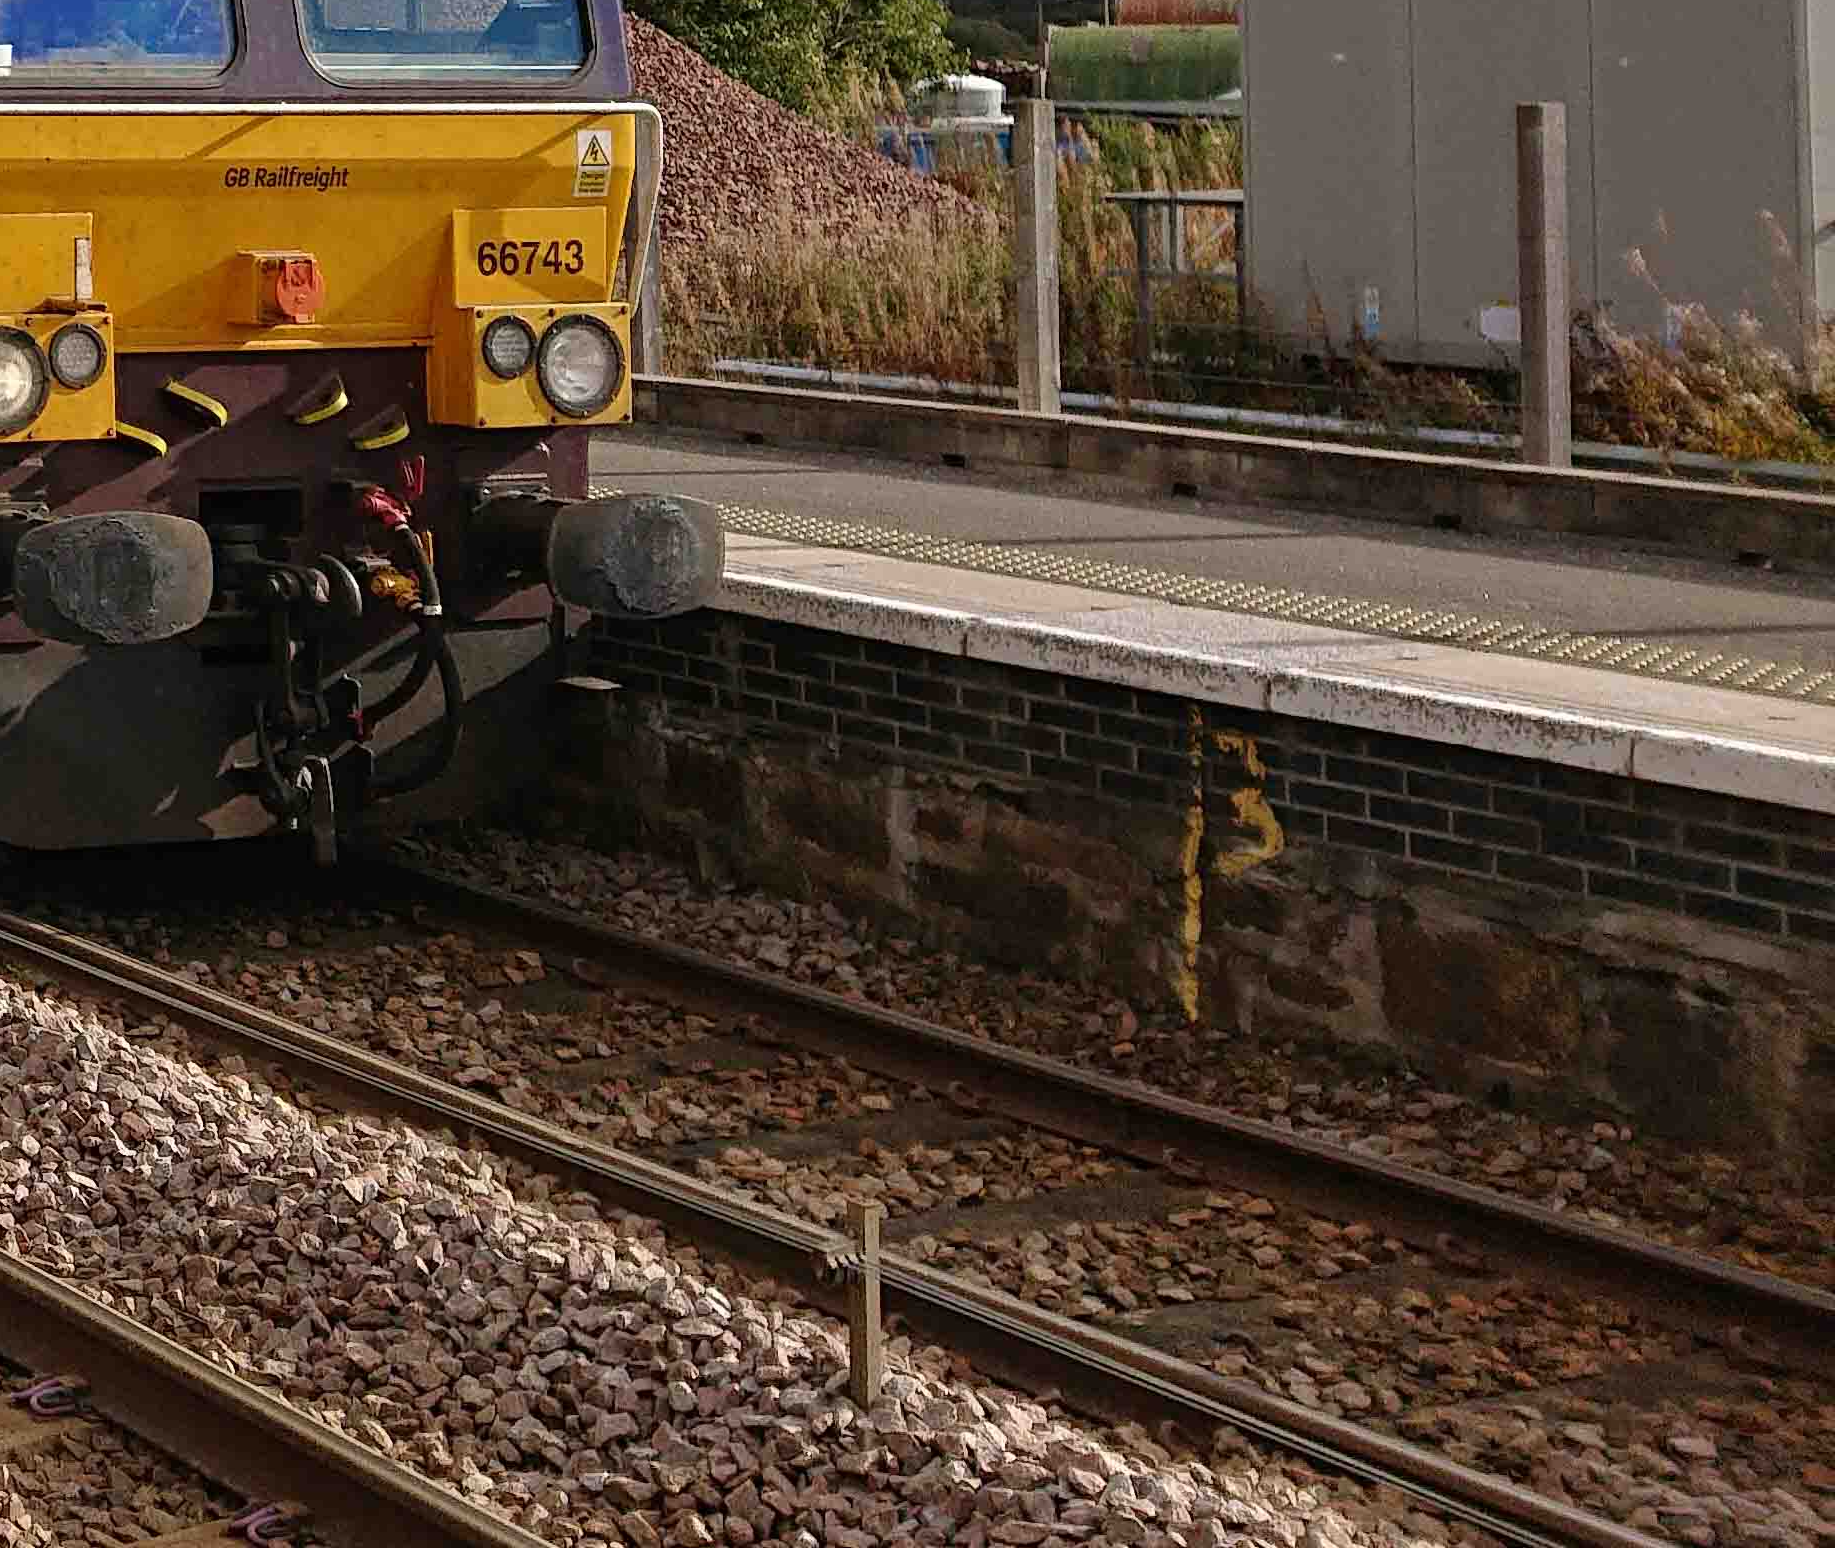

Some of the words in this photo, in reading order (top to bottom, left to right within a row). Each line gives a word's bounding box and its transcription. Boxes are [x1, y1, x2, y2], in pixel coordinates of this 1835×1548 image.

[224, 166, 250, 187] GB
[254, 165, 349, 192] Railfreight
[477, 239, 584, 276] 66743
